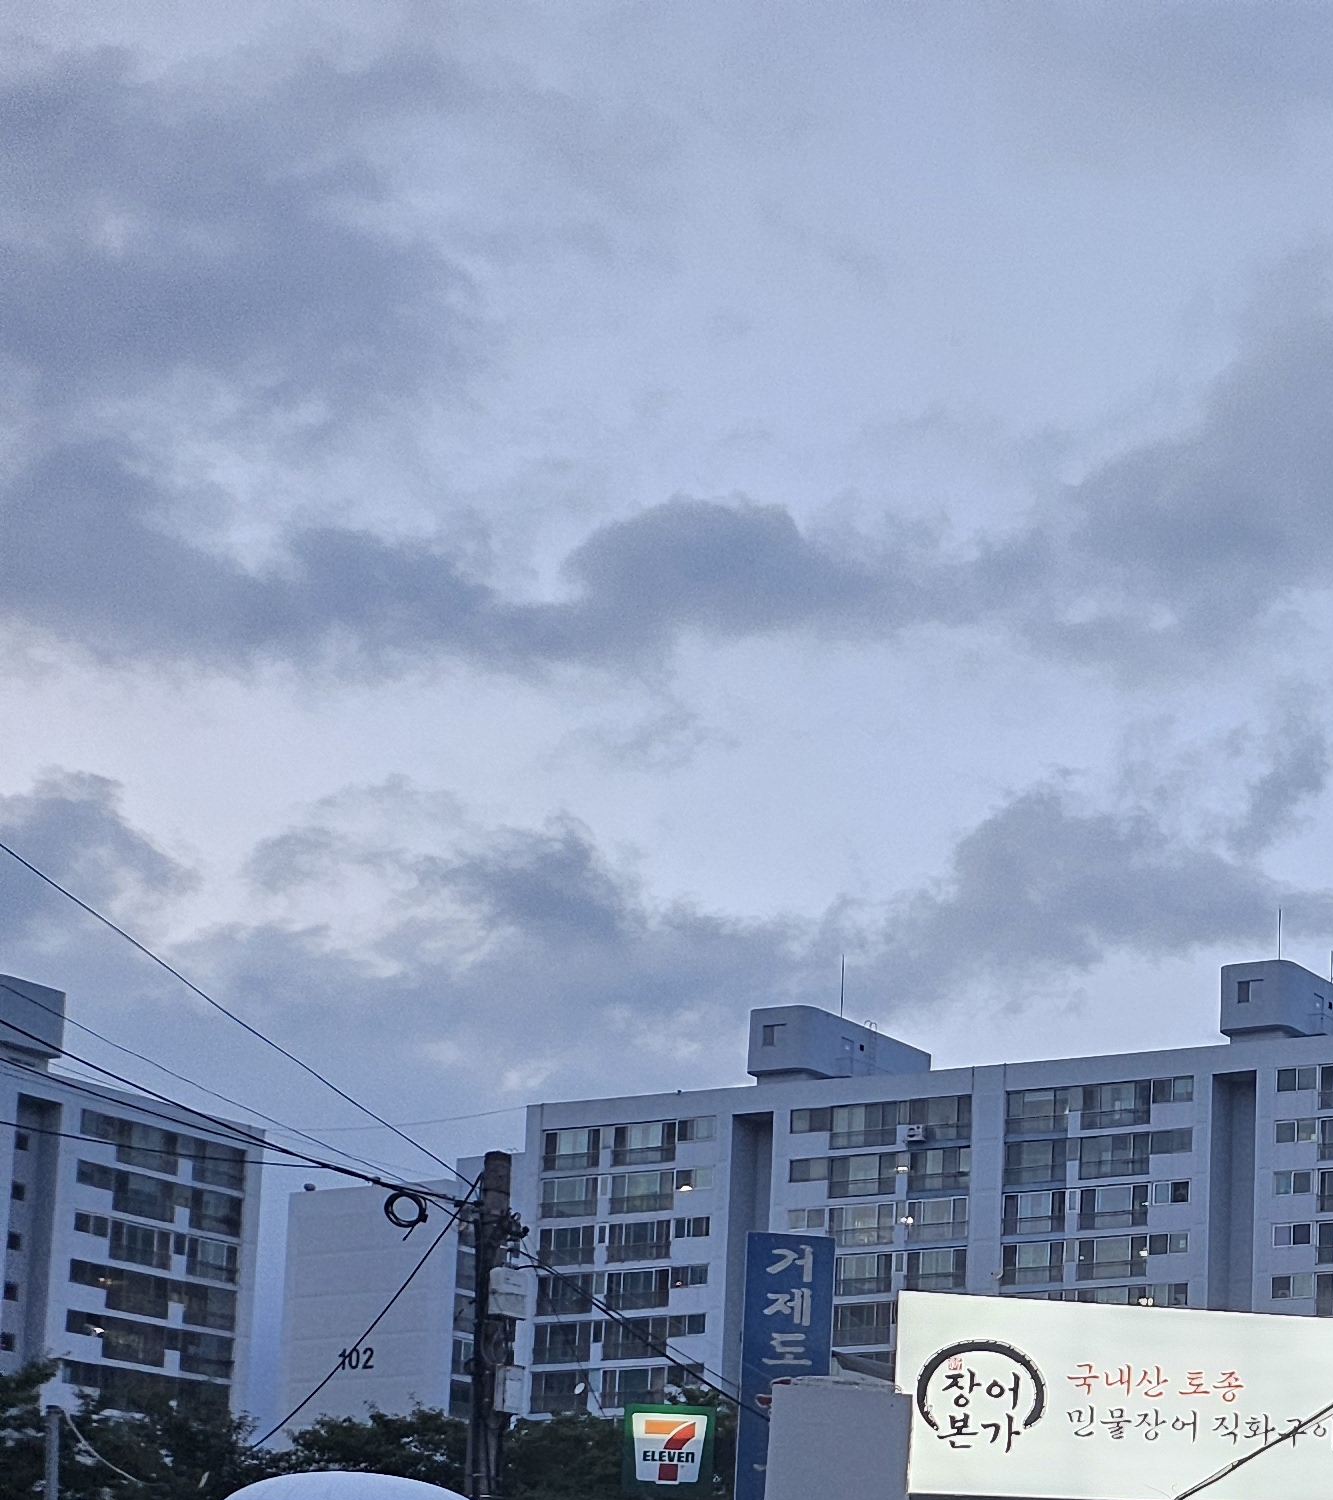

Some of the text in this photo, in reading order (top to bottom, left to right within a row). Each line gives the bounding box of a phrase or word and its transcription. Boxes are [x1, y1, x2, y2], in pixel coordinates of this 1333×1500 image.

[338, 1347, 374, 1370] 102
[942, 1368, 1020, 1410] 장어
[1067, 1363, 1244, 1402] 국내산 토종
[937, 1413, 1021, 1453] 본가
[1066, 1405, 1198, 1443] 민물장어
